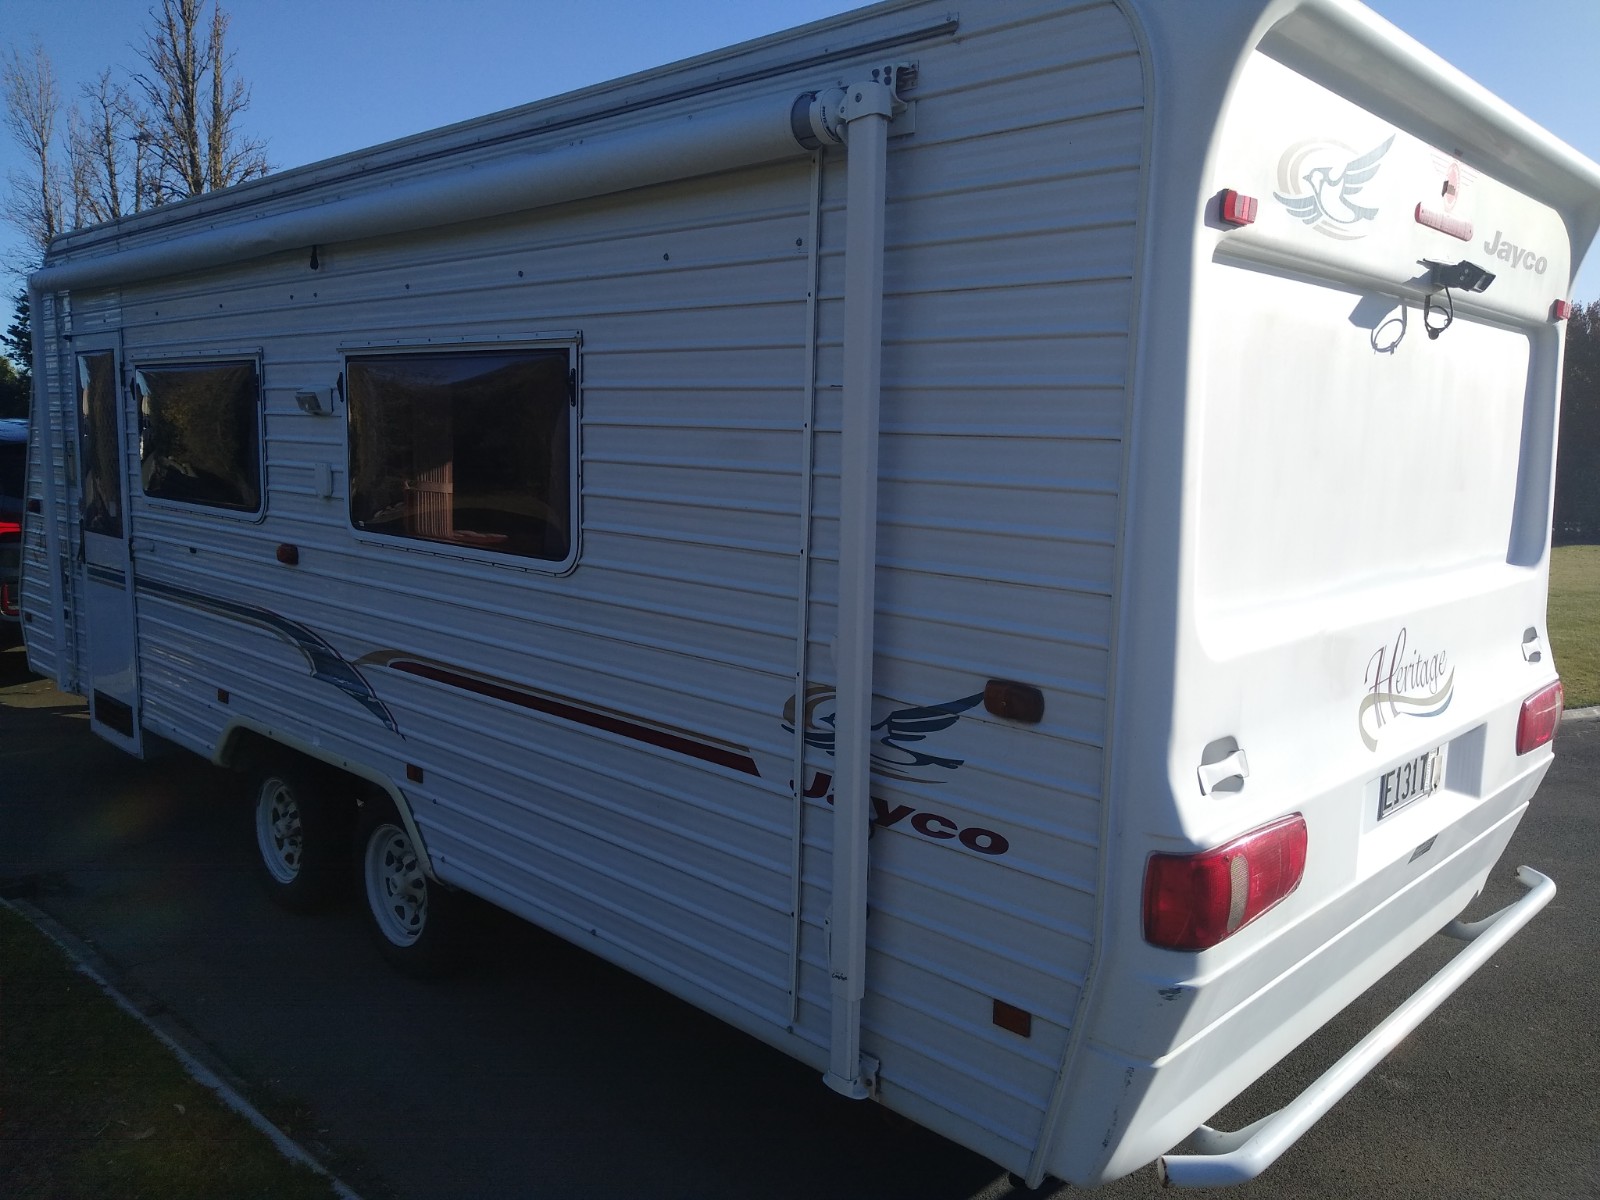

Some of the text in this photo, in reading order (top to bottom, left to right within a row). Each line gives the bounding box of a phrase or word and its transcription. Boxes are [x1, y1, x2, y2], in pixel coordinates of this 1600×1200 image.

[1484, 230, 1548, 275] Jayco
[1364, 627, 1448, 728] Heritage
[789, 772, 1010, 855] Jyco
